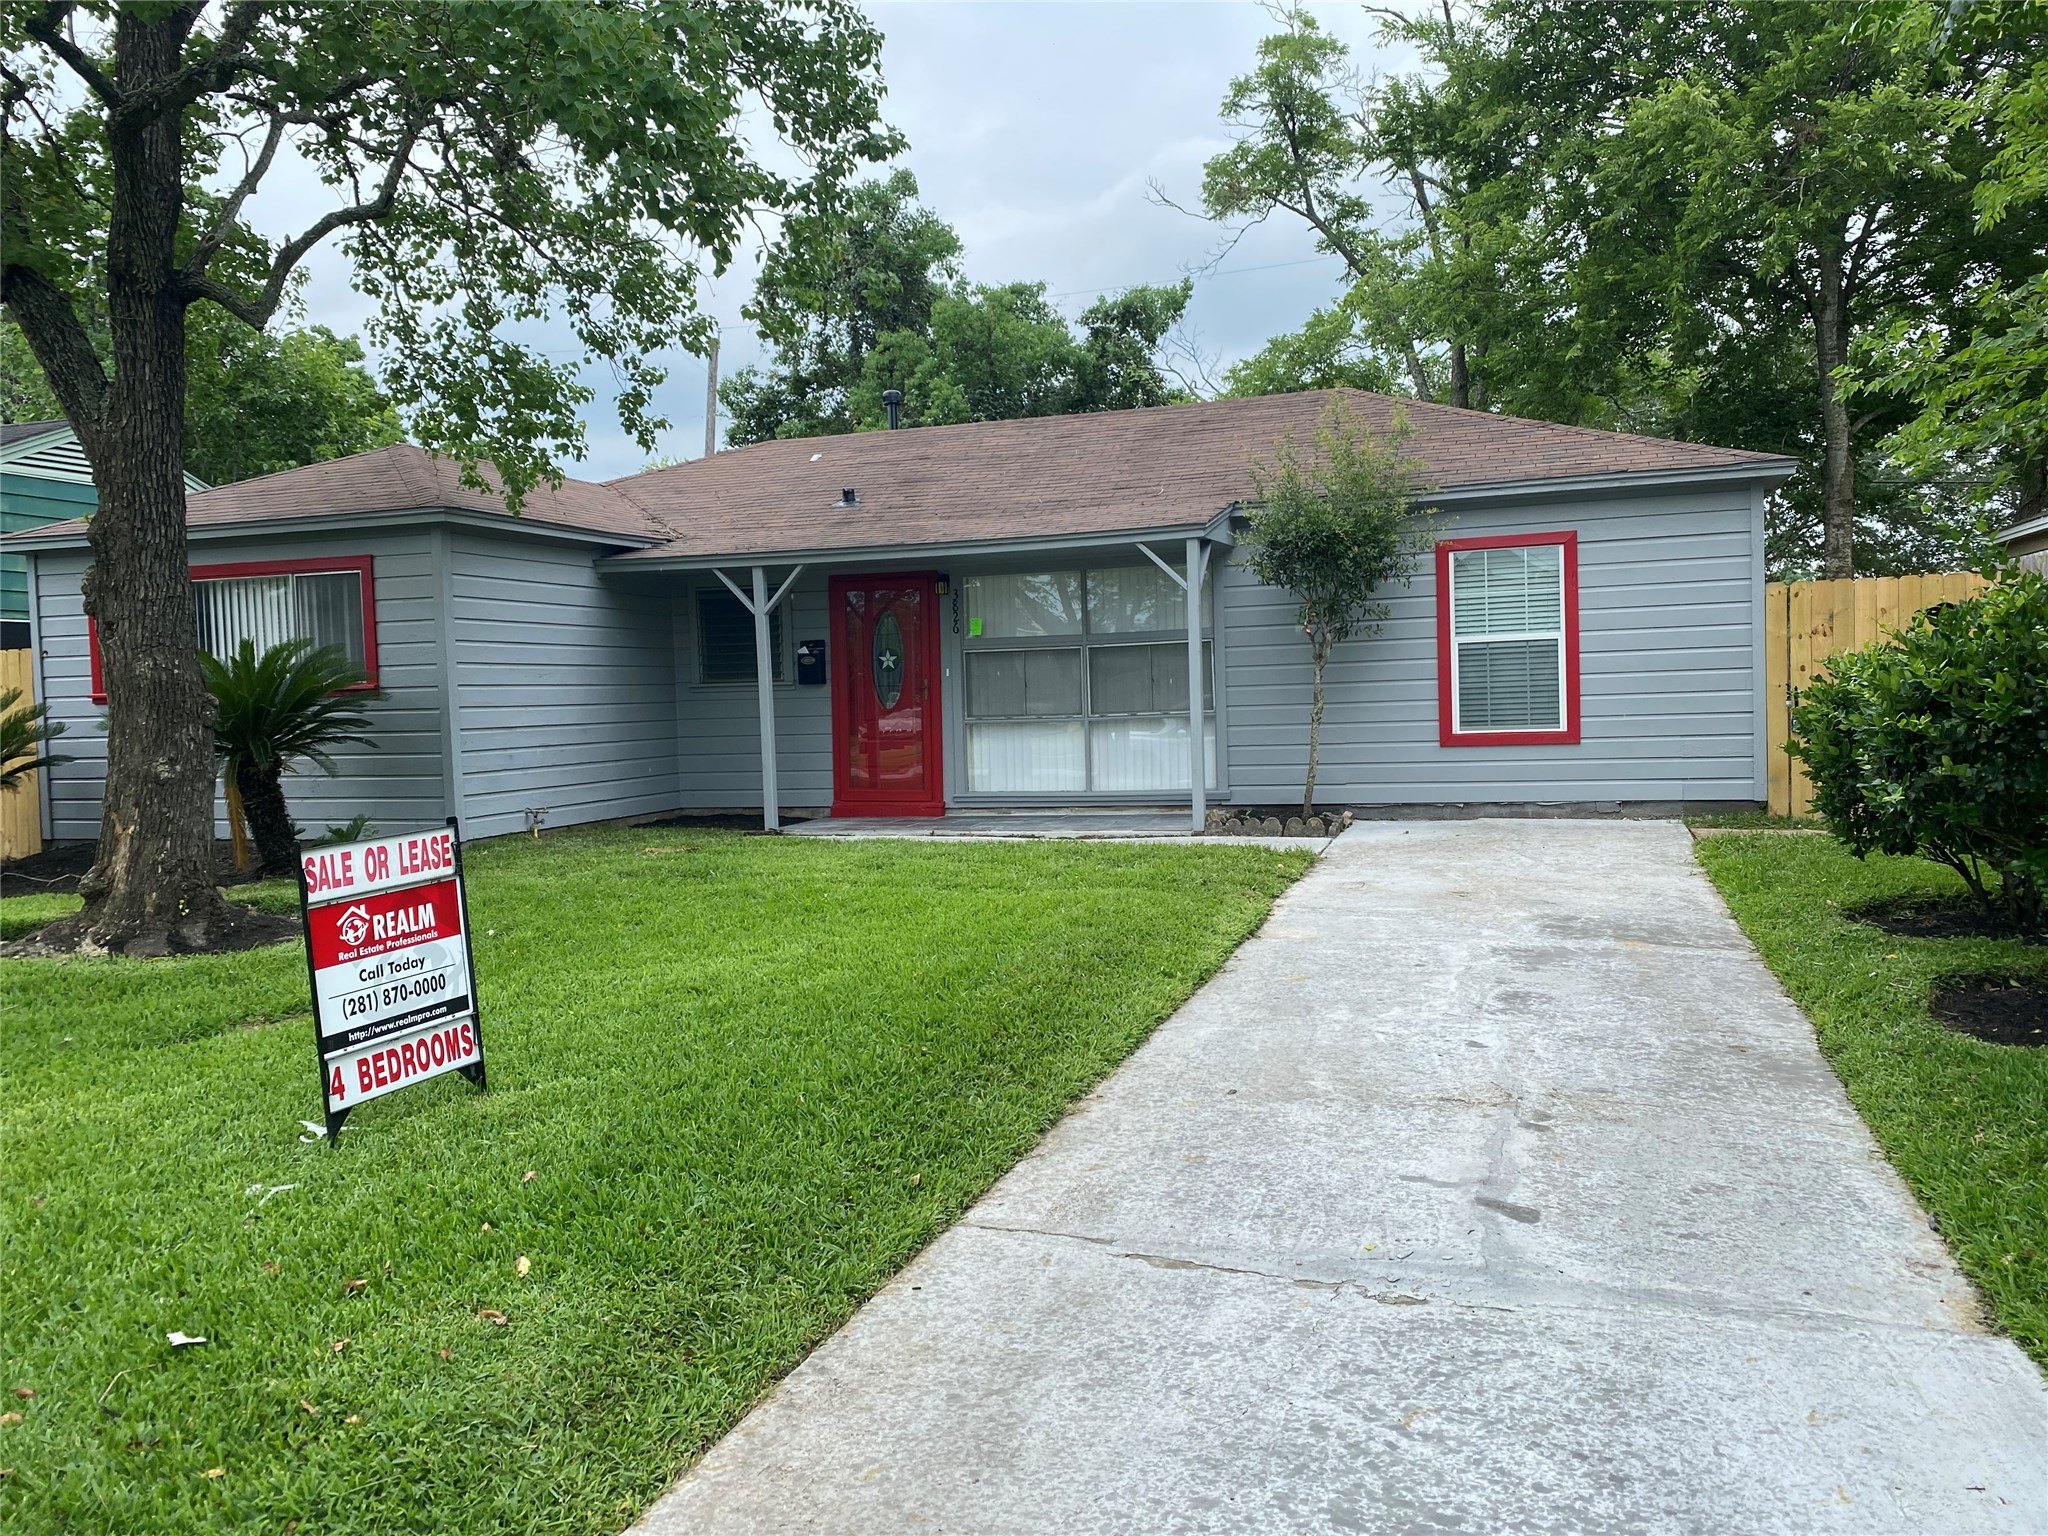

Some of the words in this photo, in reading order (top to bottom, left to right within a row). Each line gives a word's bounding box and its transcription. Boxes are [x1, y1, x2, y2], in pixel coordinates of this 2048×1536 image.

[952, 588, 960, 634] 3826
[304, 851, 354, 894] SALE
[364, 845, 390, 883] OR
[397, 834, 452, 876] LEASE
[372, 902, 436, 941] REALM
[338, 946, 357, 962] Real
[359, 942, 385, 957] Estate
[386, 930, 439, 950] Professionals
[359, 963, 384, 982] Call
[387, 956, 426, 975] Today
[342, 990, 379, 1021] (281)
[383, 973, 446, 1007] 870-0000
[348, 1005, 448, 1042] http://www.realmpro.com
[330, 1066, 346, 1101] 4
[356, 1023, 475, 1094] BEDROOMS
